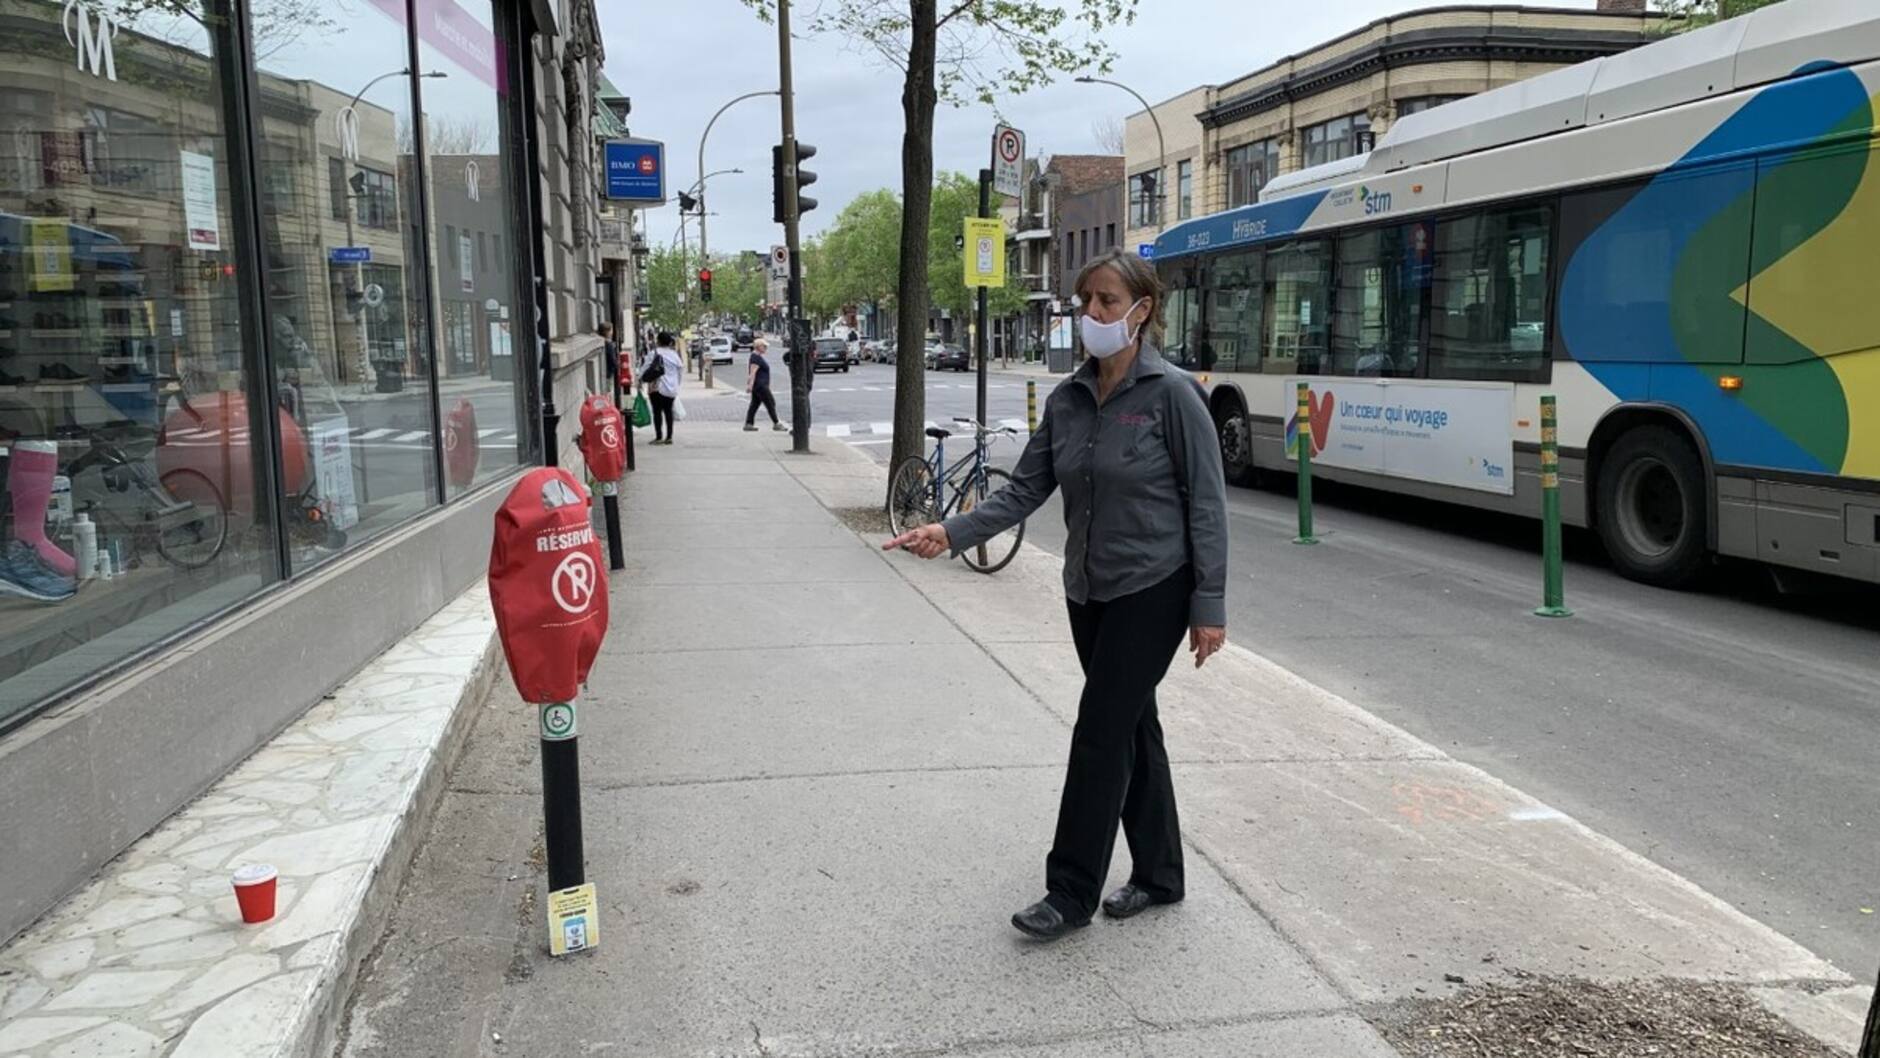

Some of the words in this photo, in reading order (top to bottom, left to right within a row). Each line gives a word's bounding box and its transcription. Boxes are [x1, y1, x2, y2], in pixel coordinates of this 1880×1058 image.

[611, 160, 636, 169] BMO
[1365, 191, 1392, 215] stm
[1340, 401, 1354, 417] Un
[1355, 404, 1383, 419] cœur
[1385, 405, 1402, 425] qui
[1405, 409, 1448, 429] voyage
[1487, 463, 1504, 478] stm
